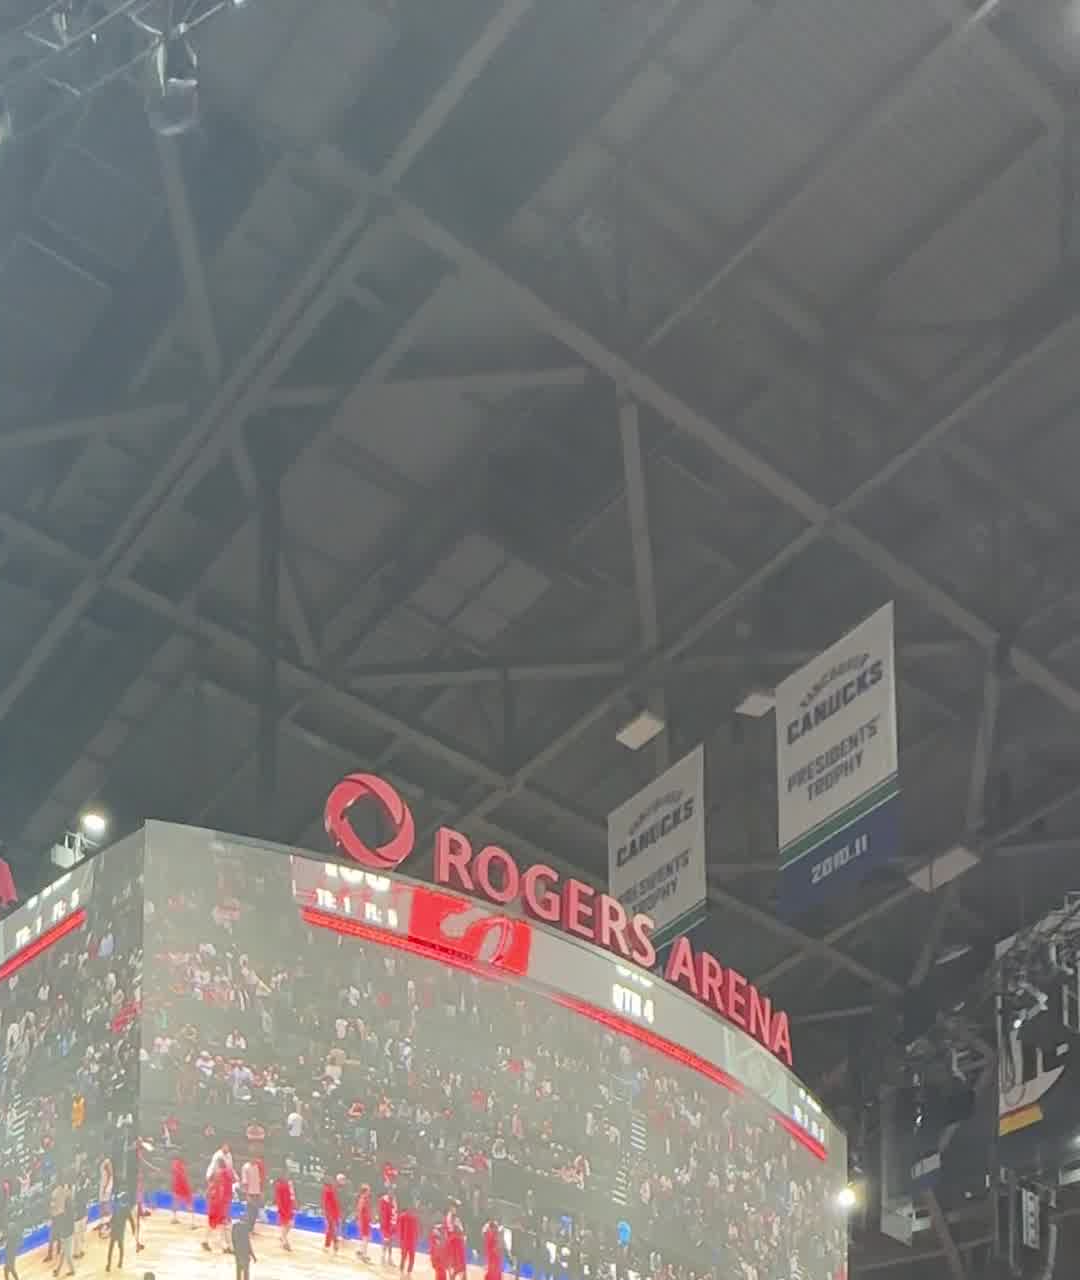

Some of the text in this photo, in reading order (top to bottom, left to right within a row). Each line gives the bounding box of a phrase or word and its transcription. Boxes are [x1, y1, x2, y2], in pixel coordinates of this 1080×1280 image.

[786, 659, 884, 745] CANUCKS
[616, 796, 695, 867] CANUCKS
[435, 825, 657, 968] ROGERS
[665, 936, 793, 1067] ARENA
